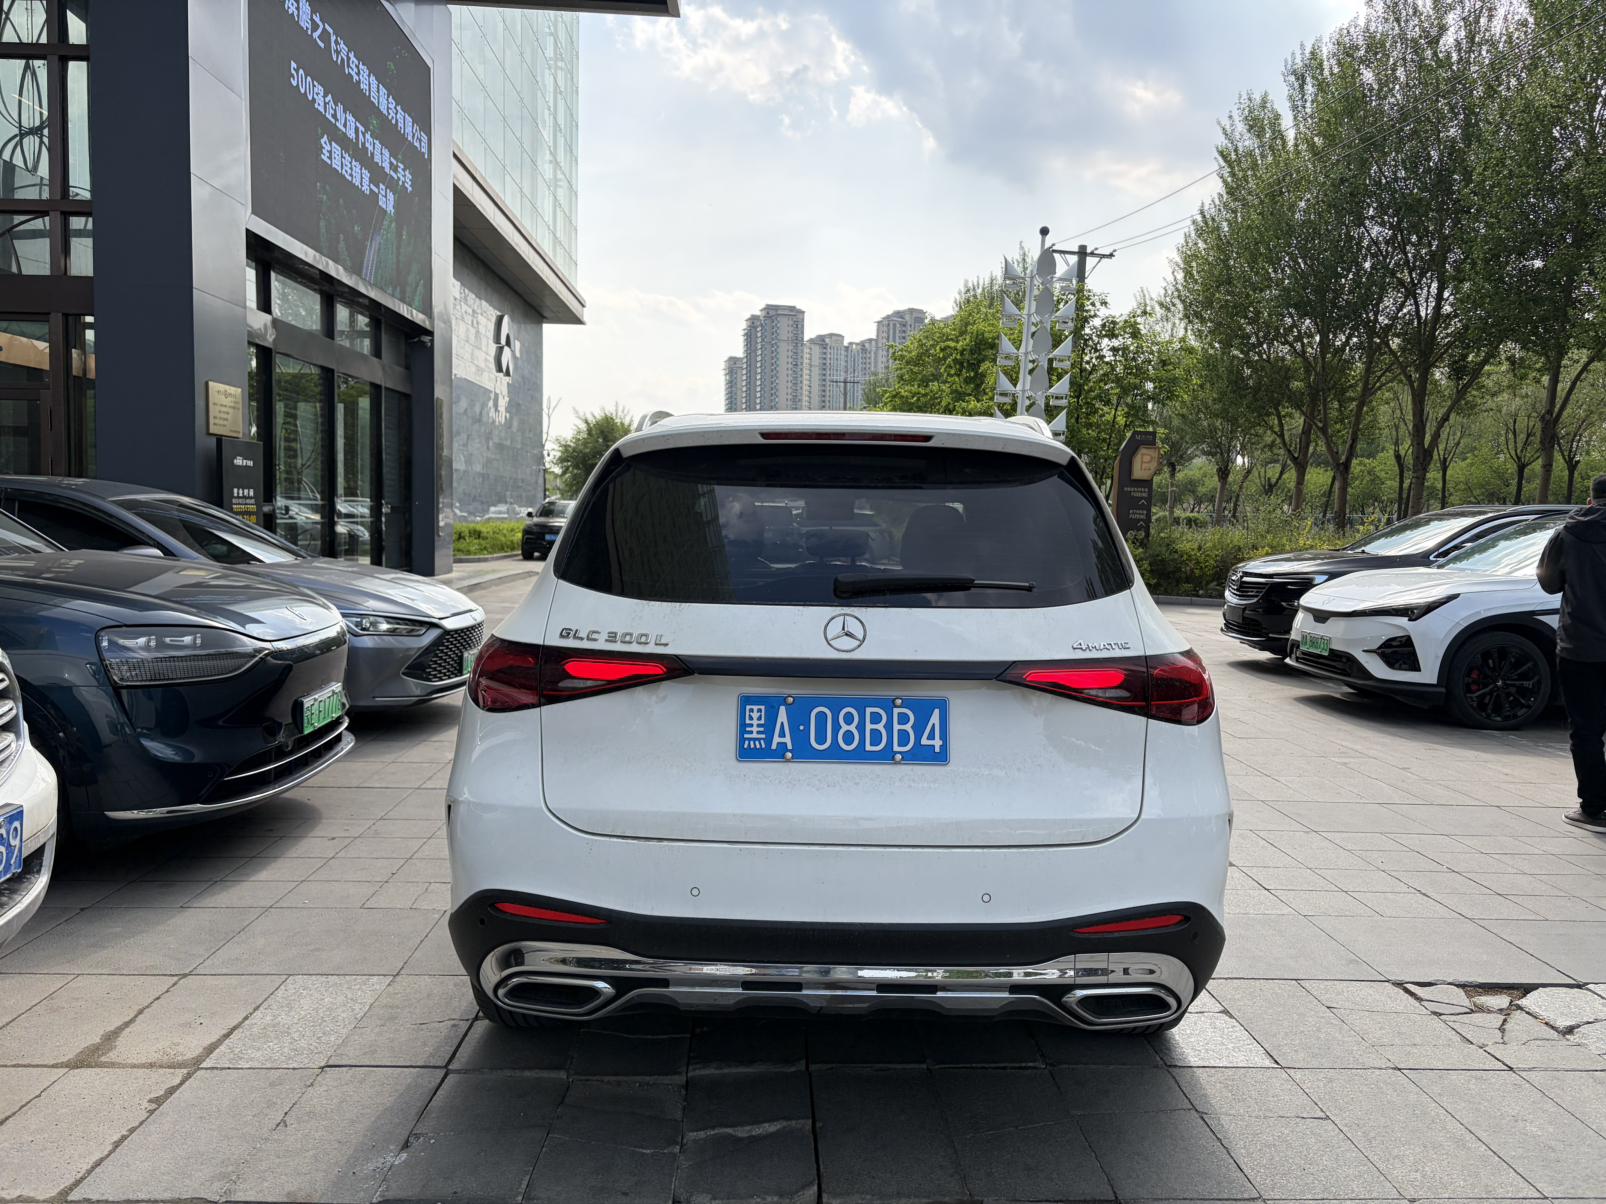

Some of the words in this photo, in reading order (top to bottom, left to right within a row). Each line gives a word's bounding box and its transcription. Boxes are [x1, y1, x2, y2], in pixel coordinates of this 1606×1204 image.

[290, 60, 413, 193] 500强企业旗下中高端二手车
[320, 133, 395, 216] 全国连锁第一品牌
[559, 627, 602, 642] GLC
[605, 631, 651, 646] 300
[655, 634, 669, 647] L
[1072, 640, 1131, 652] 4MATIC
[744, 704, 943, 753] 黑A·08BB4
